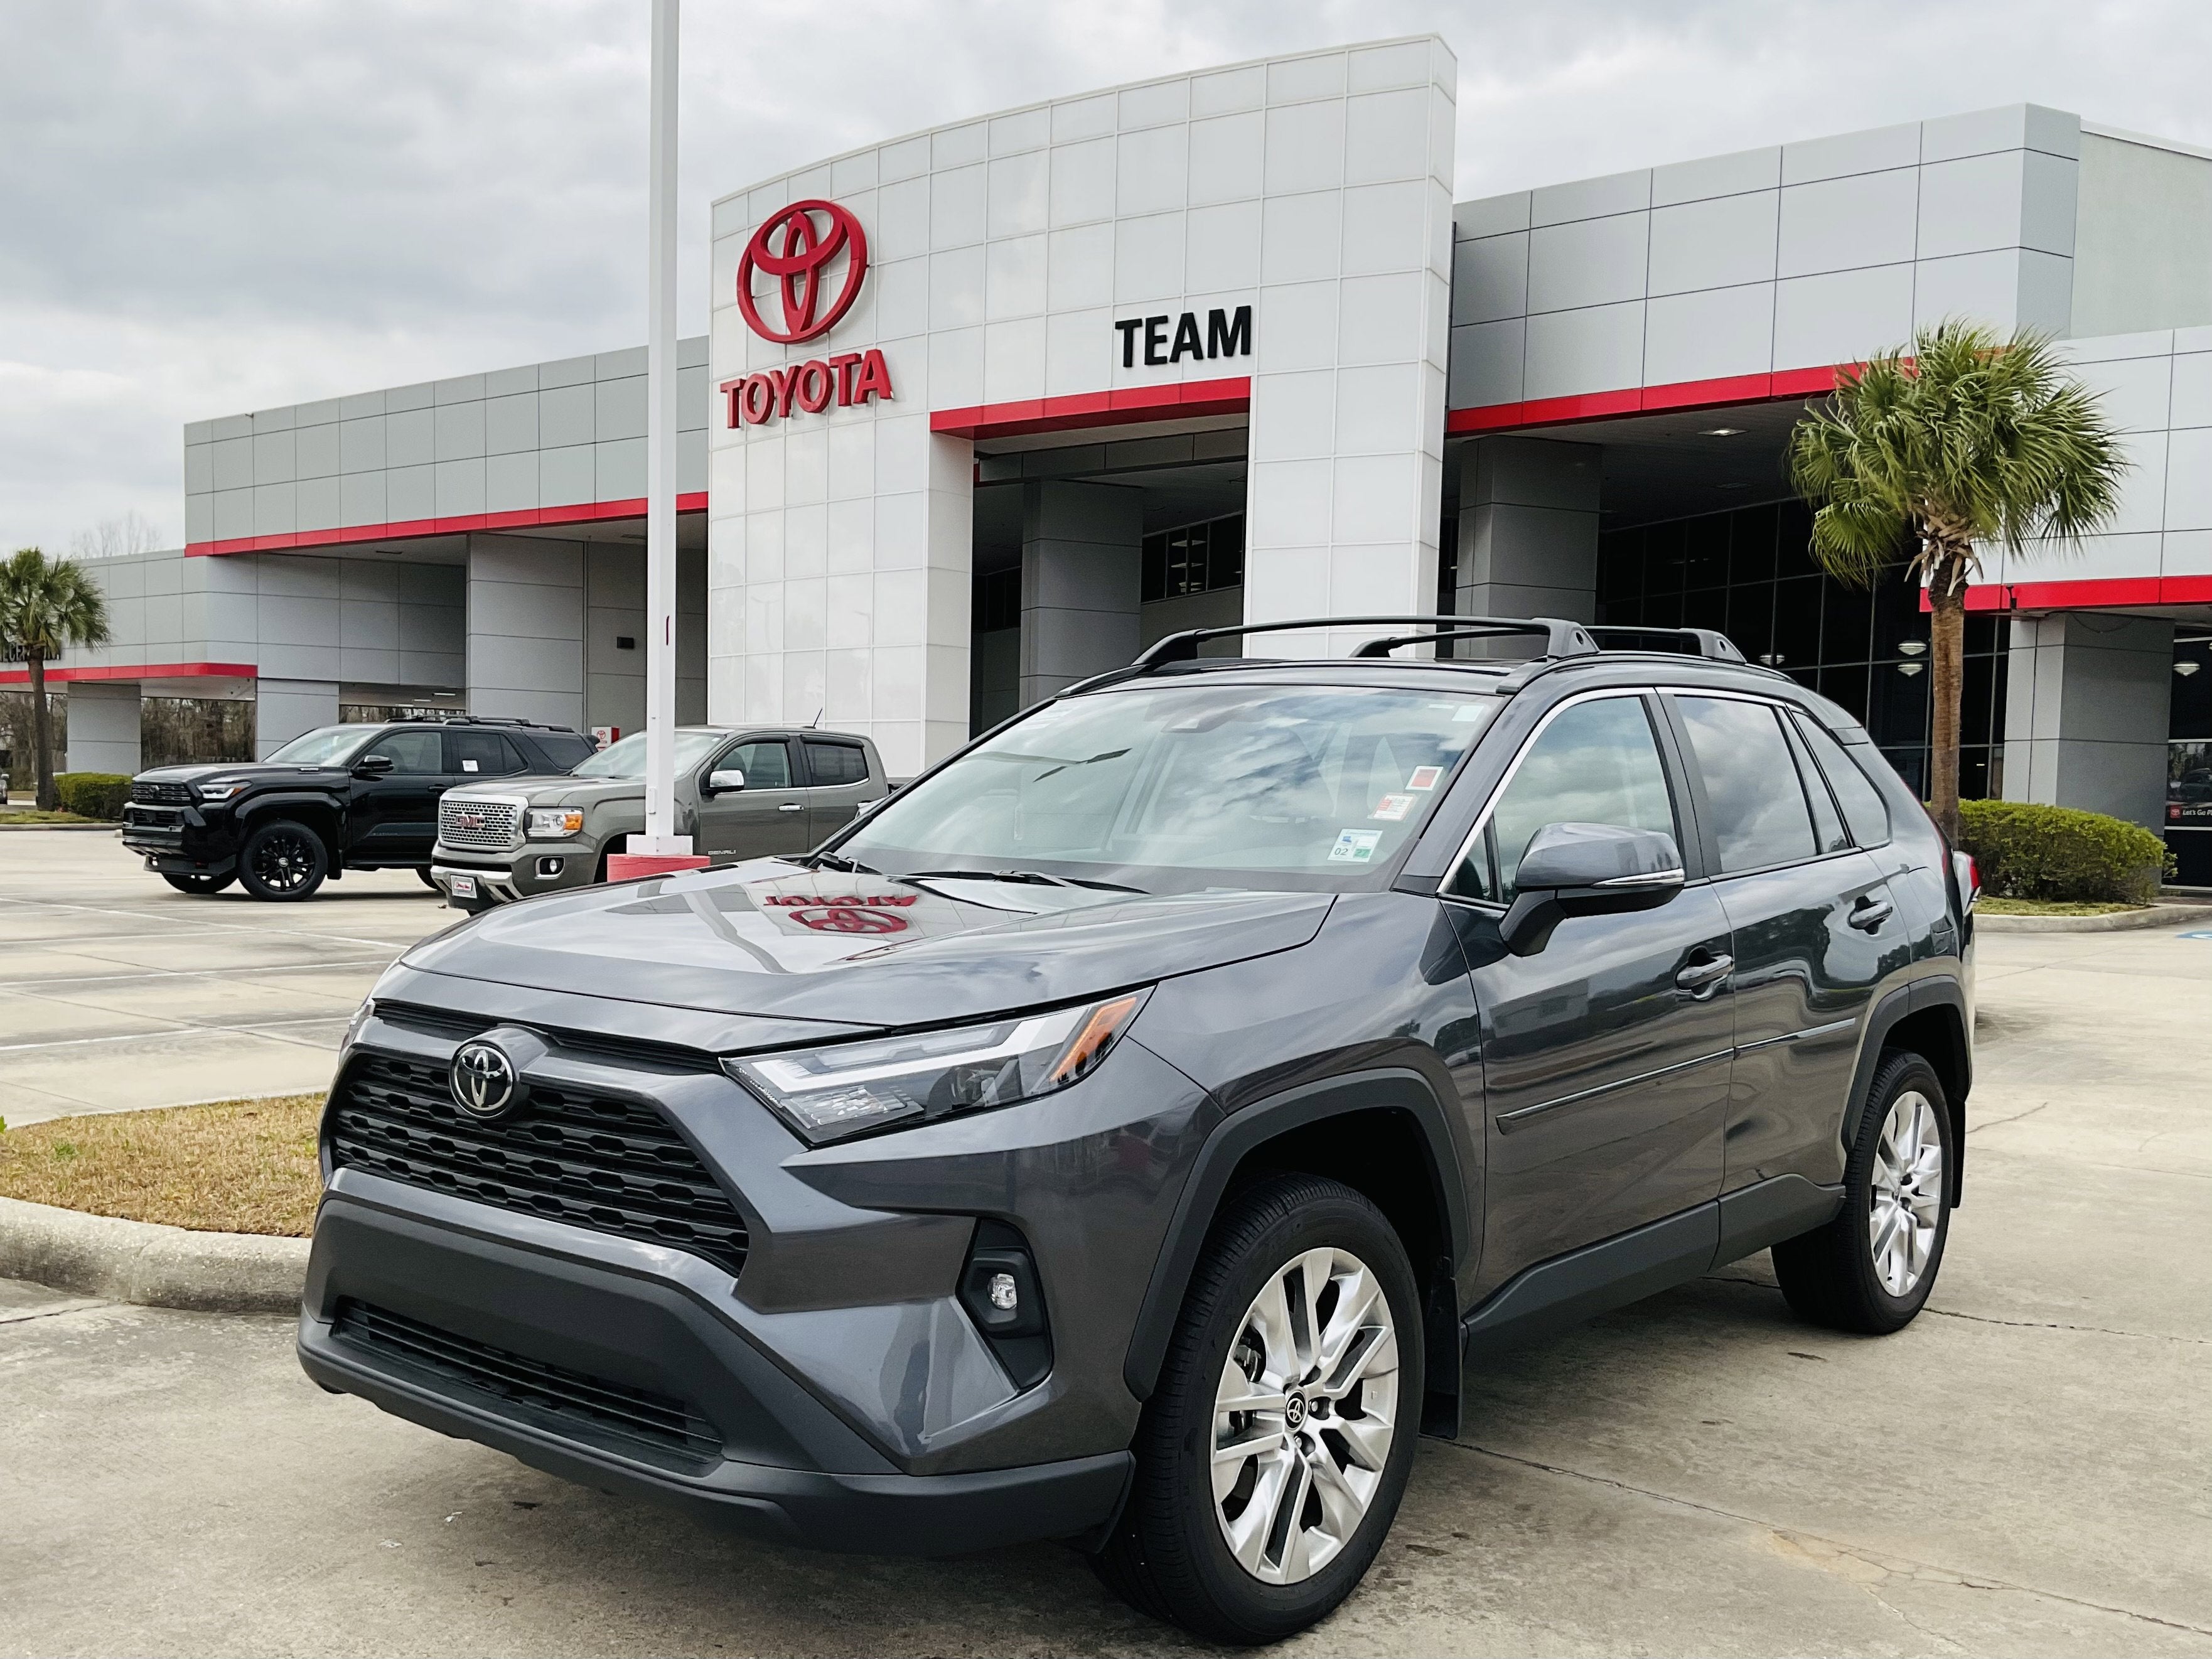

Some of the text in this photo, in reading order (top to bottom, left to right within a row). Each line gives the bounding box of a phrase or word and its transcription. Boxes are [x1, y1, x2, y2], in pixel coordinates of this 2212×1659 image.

[1115, 305, 1252, 368] TEAM
[721, 349, 894, 429] TOYOTA
[456, 815, 485, 828] GMC
[1334, 847, 1370, 857] 02 27
